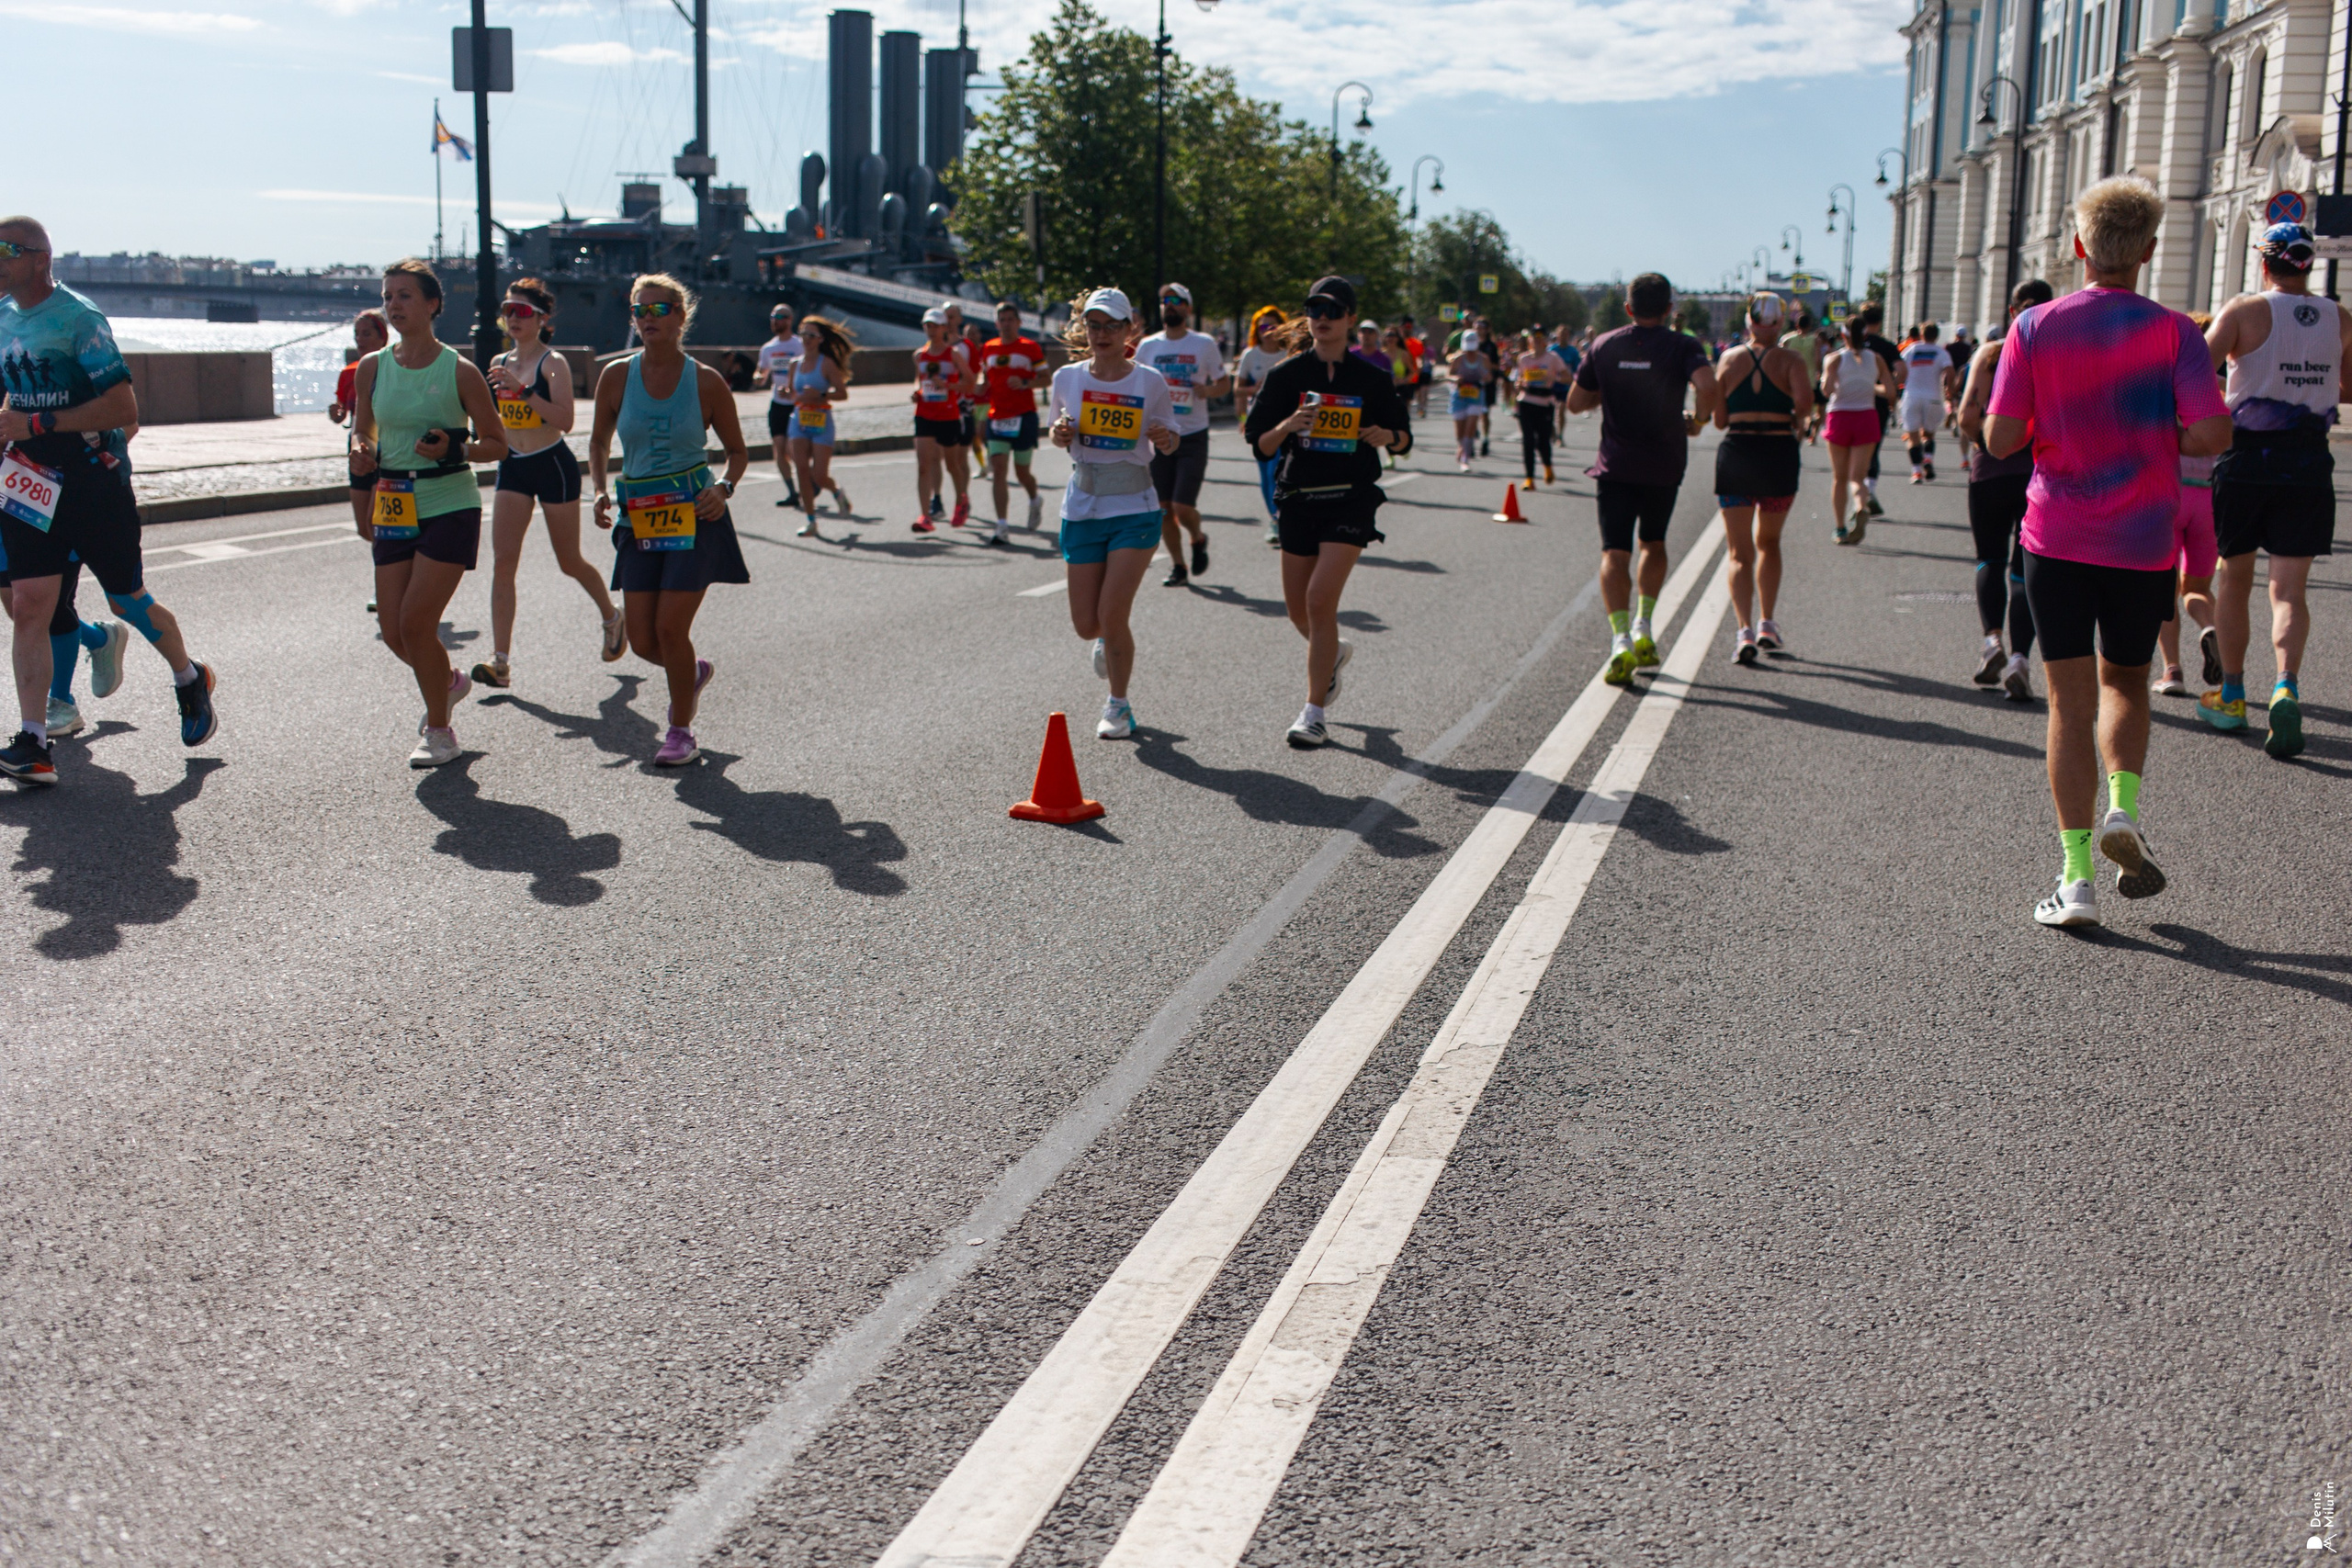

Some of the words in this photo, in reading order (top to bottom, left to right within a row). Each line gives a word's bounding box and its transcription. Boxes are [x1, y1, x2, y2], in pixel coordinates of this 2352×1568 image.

[2279, 363, 2302, 371] run
[2304, 360, 2331, 373] beer
[2284, 376, 2325, 388] repeat
[502, 404, 533, 420] 4969
[1090, 407, 1135, 429] 1985
[1318, 411, 1352, 429] 980
[648, 415, 673, 469] RUN
[1084, 435, 1091, 446] D
[5, 471, 52, 506] 6980
[380, 496, 403, 515] 768
[645, 508, 684, 527] 774
[643, 539, 651, 549] D
